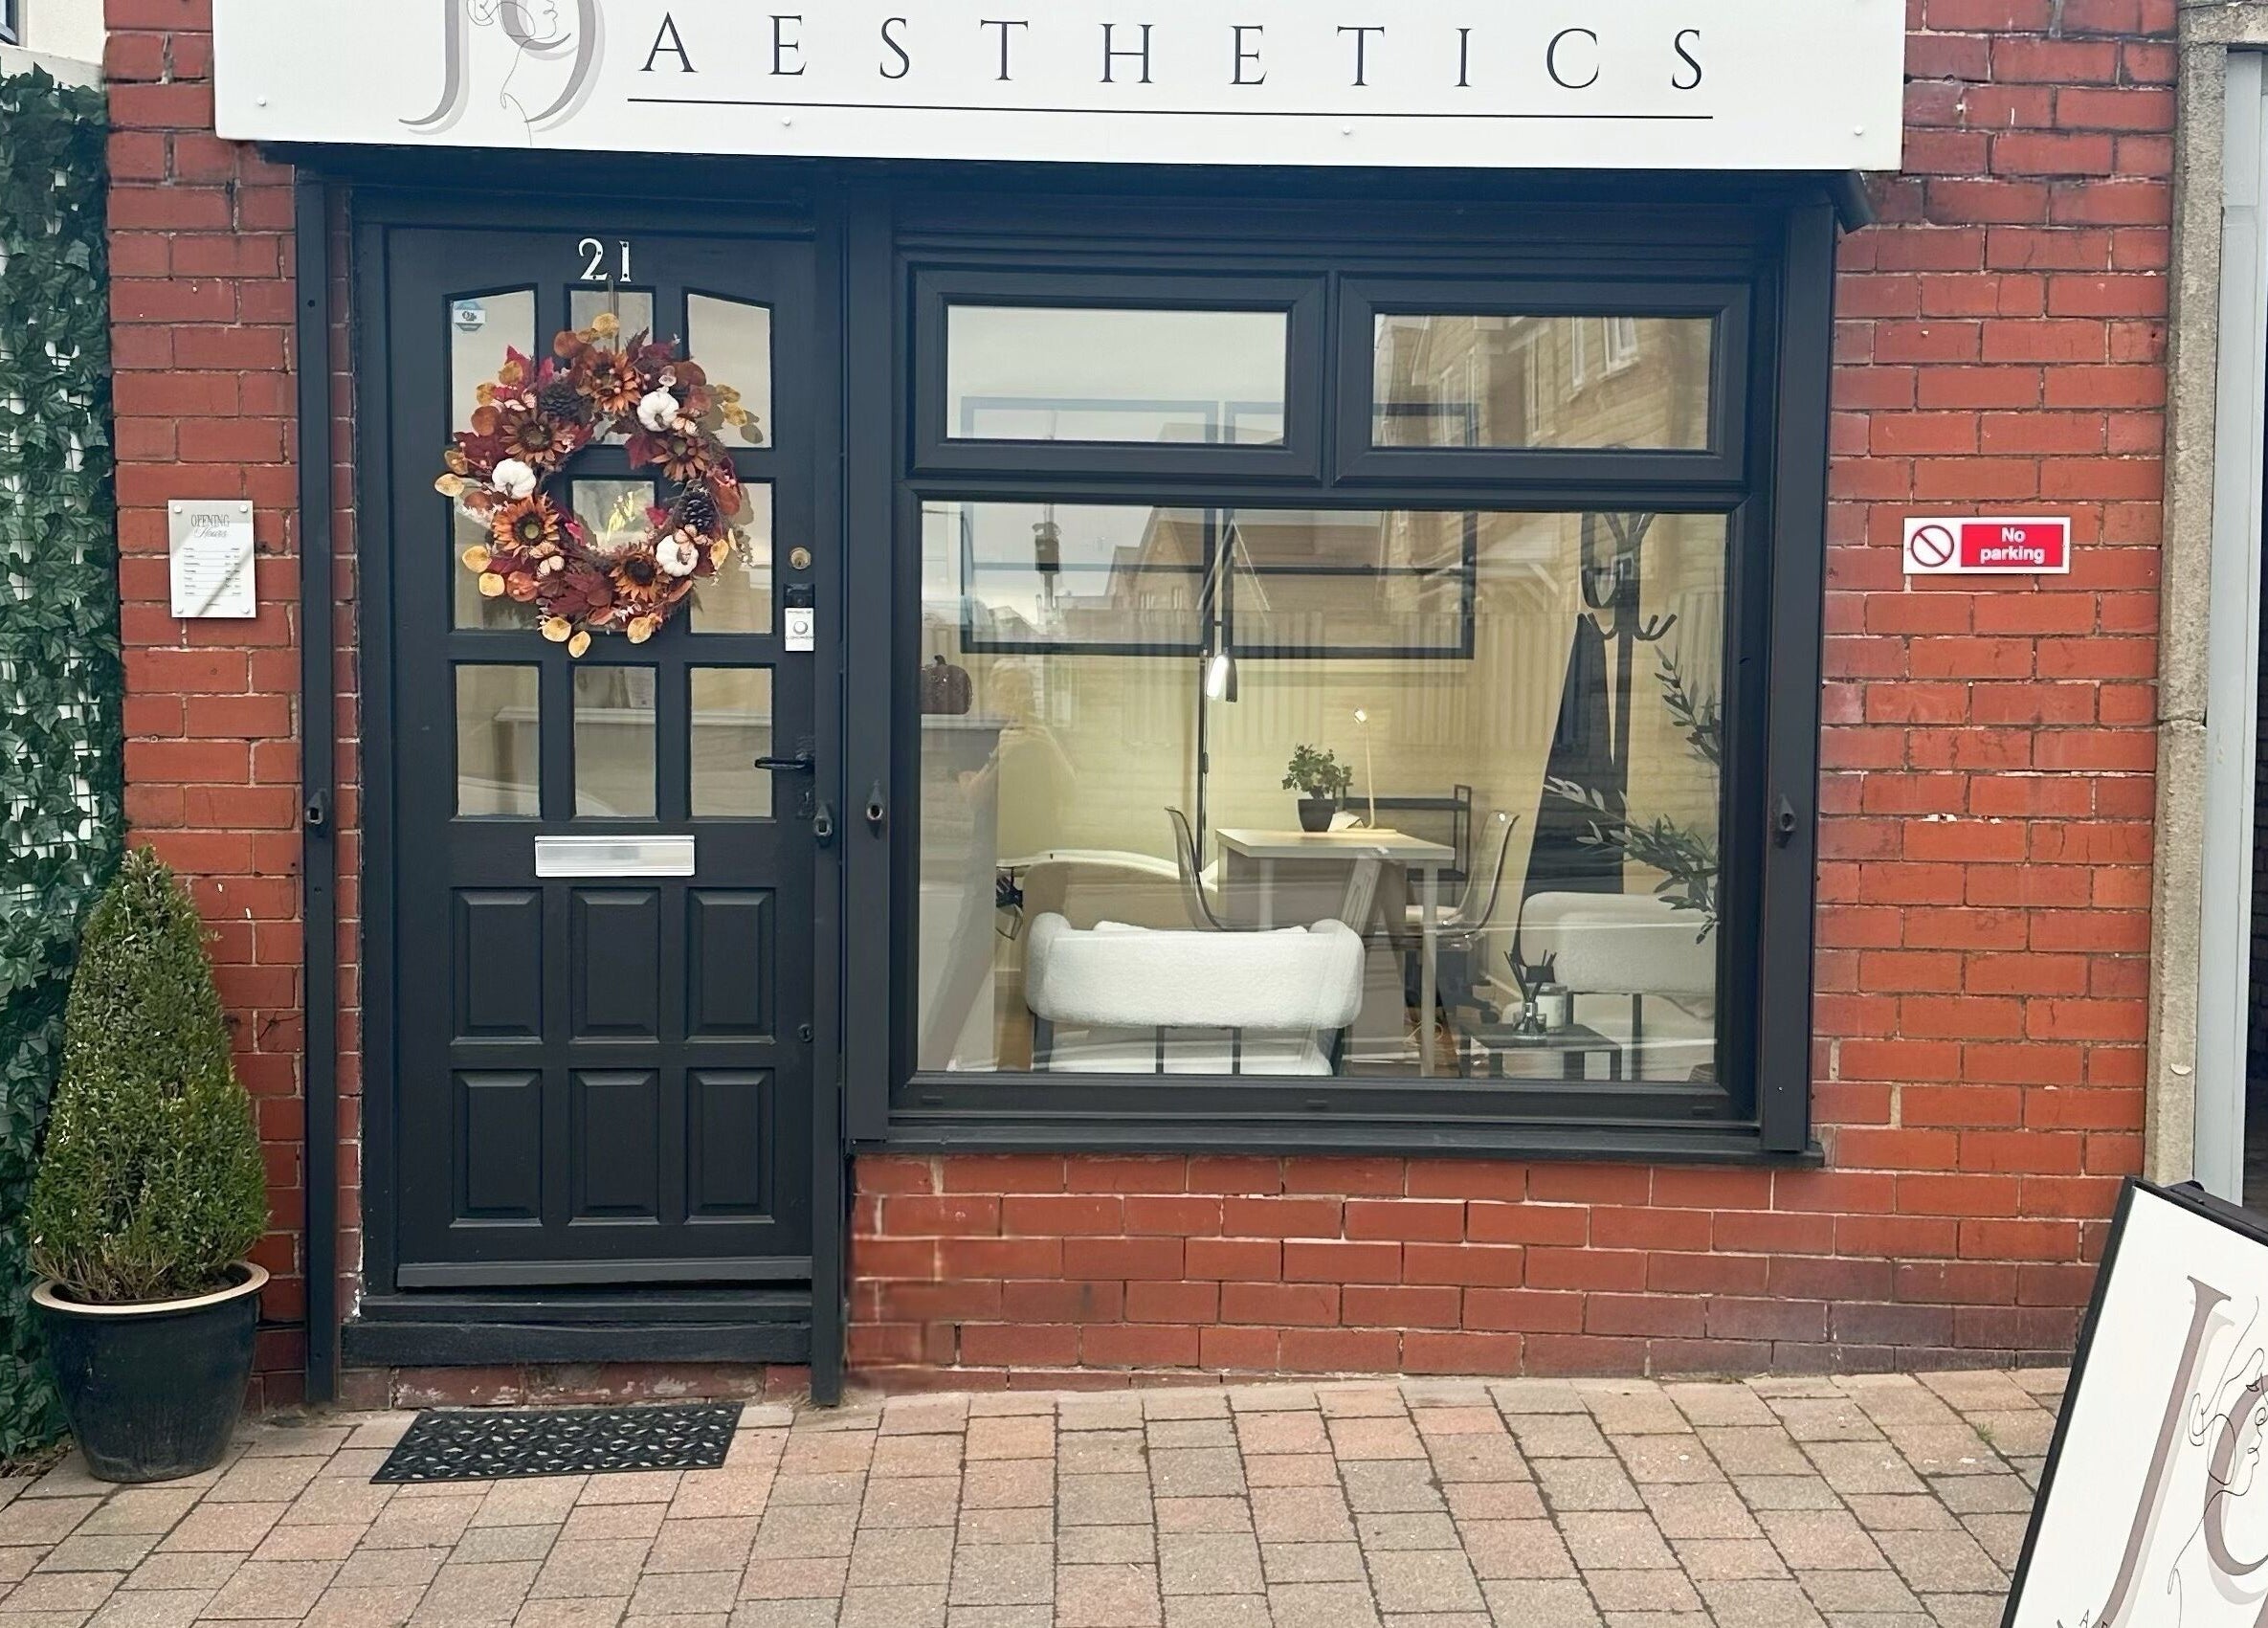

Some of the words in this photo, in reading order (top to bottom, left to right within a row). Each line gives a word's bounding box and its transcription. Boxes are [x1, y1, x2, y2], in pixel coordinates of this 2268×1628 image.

[639, 11, 1703, 90] AESTHETICS
[578, 237, 632, 282] 21
[2001, 526, 2027, 544] No
[1979, 546, 2046, 565] parking
